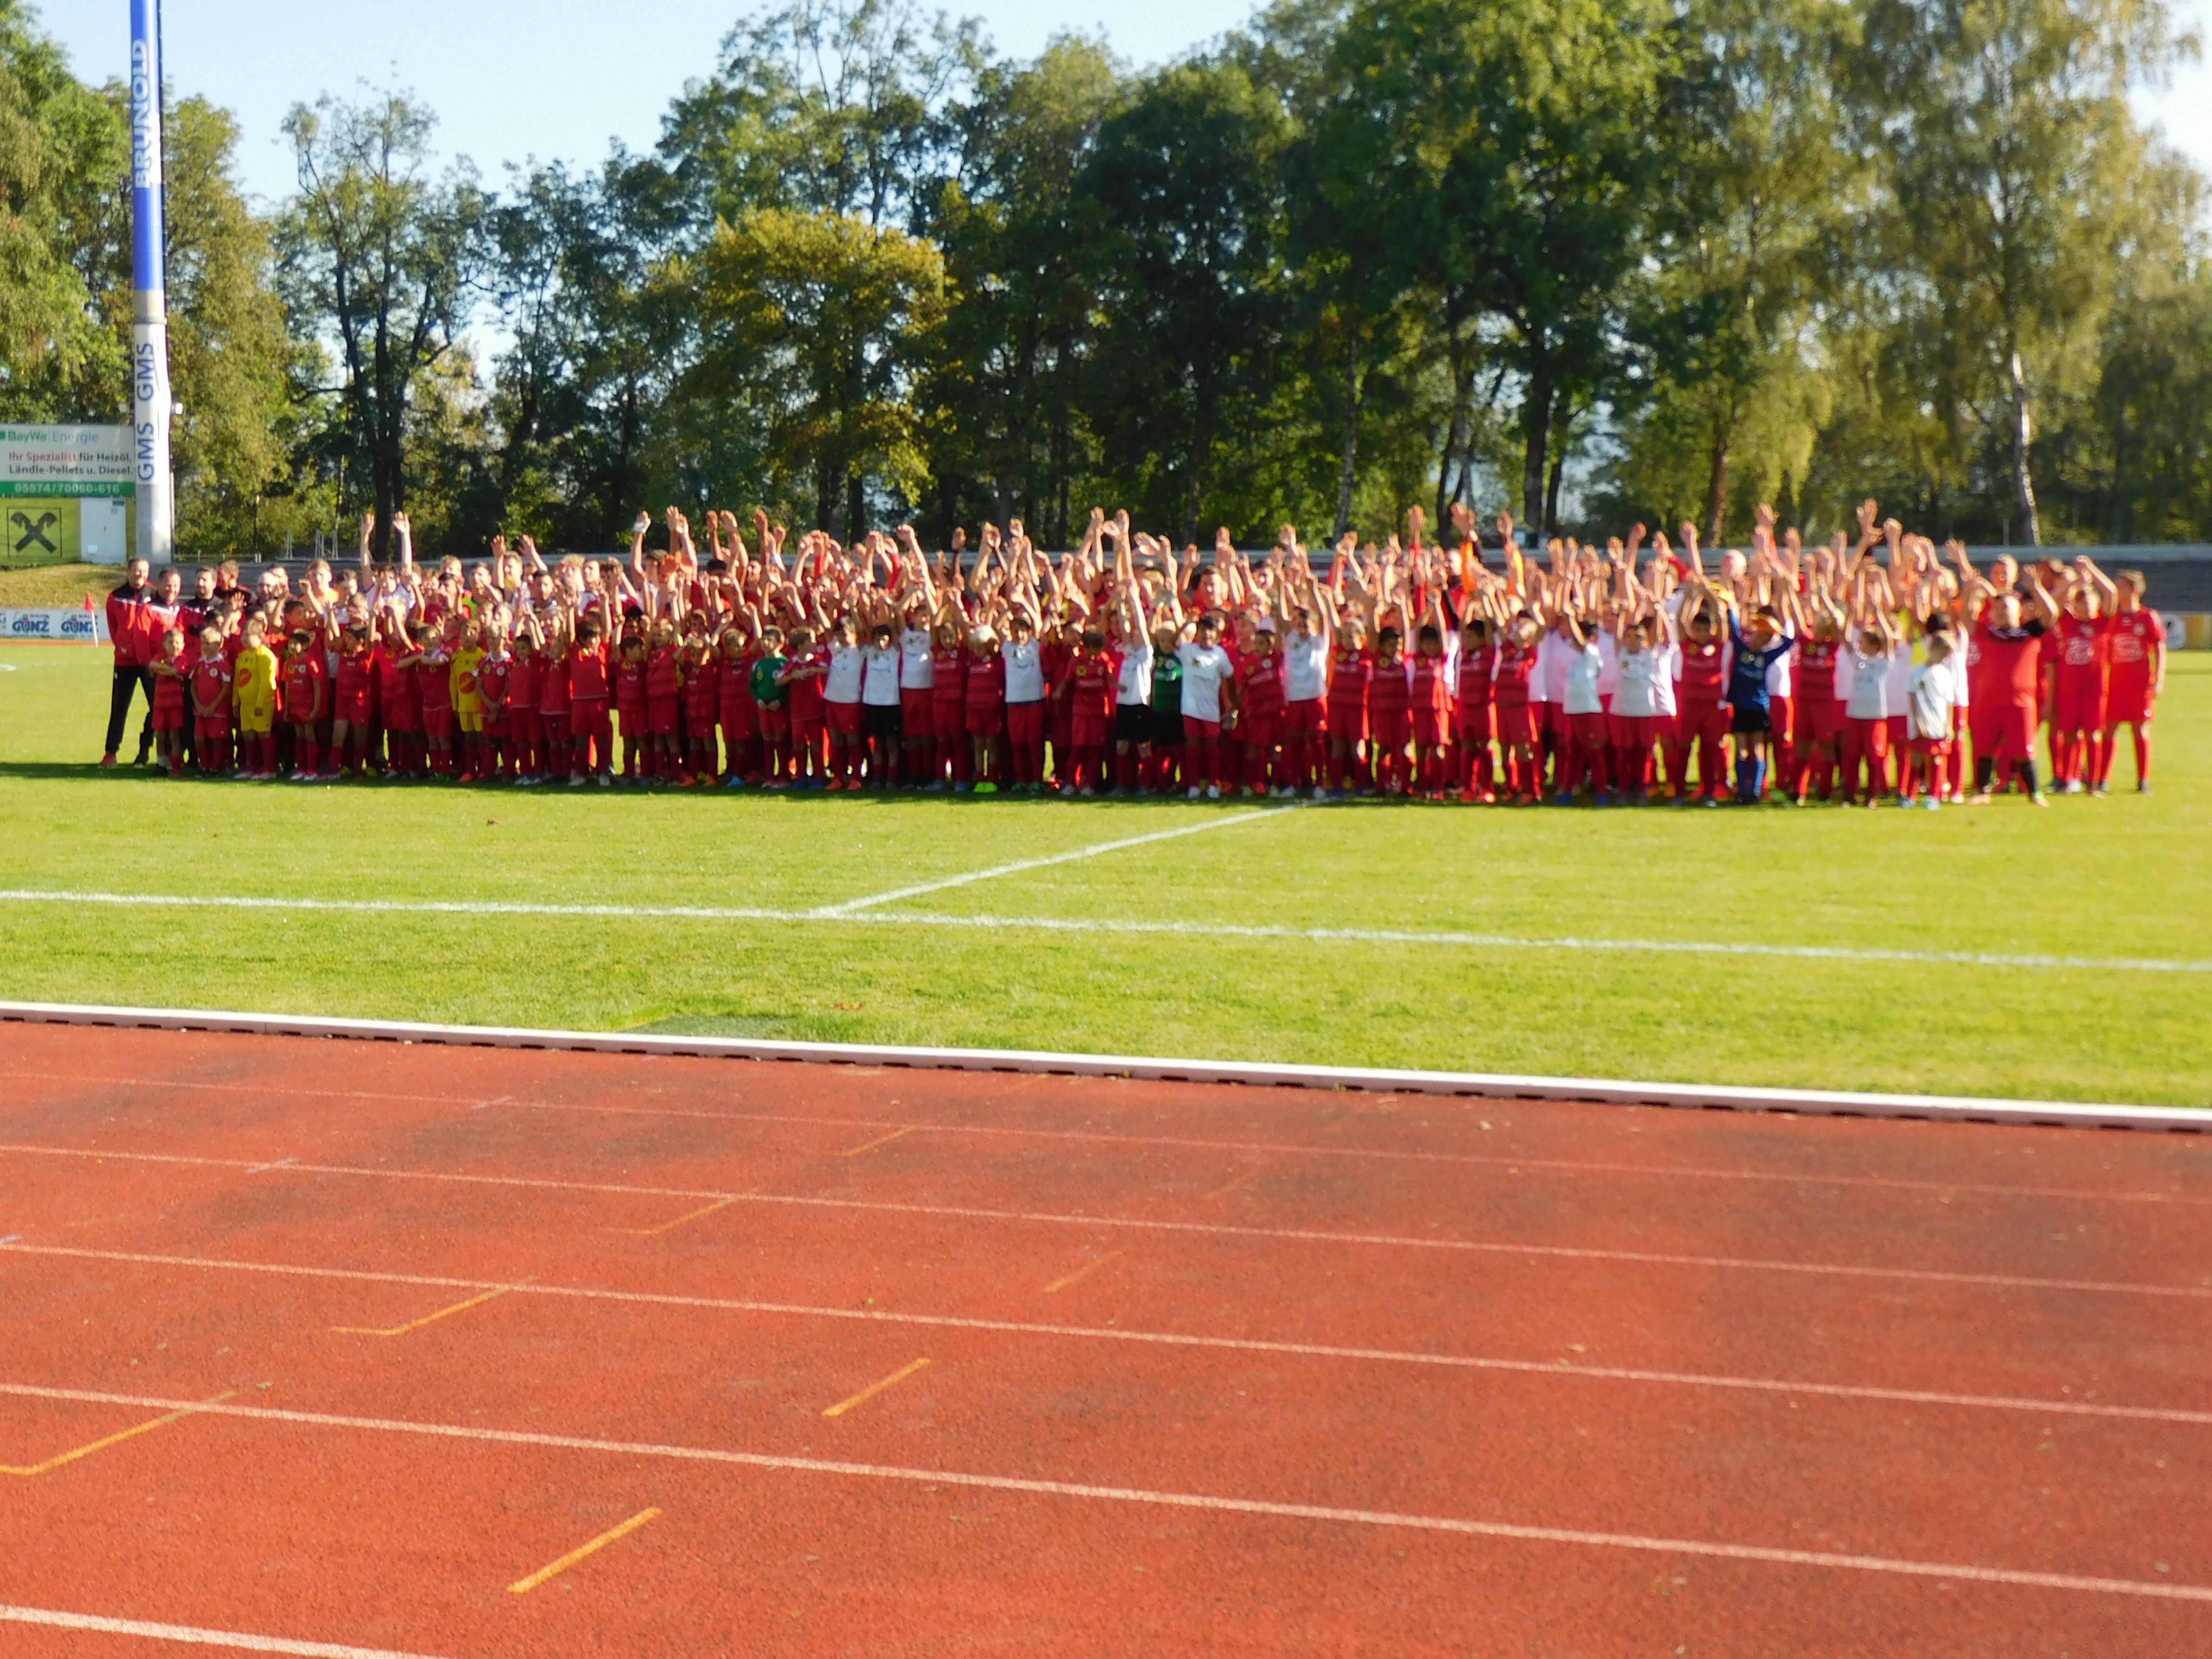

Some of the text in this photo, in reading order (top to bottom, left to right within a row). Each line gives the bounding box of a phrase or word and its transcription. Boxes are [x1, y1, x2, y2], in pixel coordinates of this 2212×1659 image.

[132, 38, 151, 188] BRUNOLD
[137, 343, 153, 401] GMS
[8, 431, 99, 446] BayWa Energie
[137, 422, 154, 480] GMS
[9, 452, 132, 463] Ihr Spezialist für Heizöl,
[9, 465, 133, 475] Ländle-Pellets u. Diesel.
